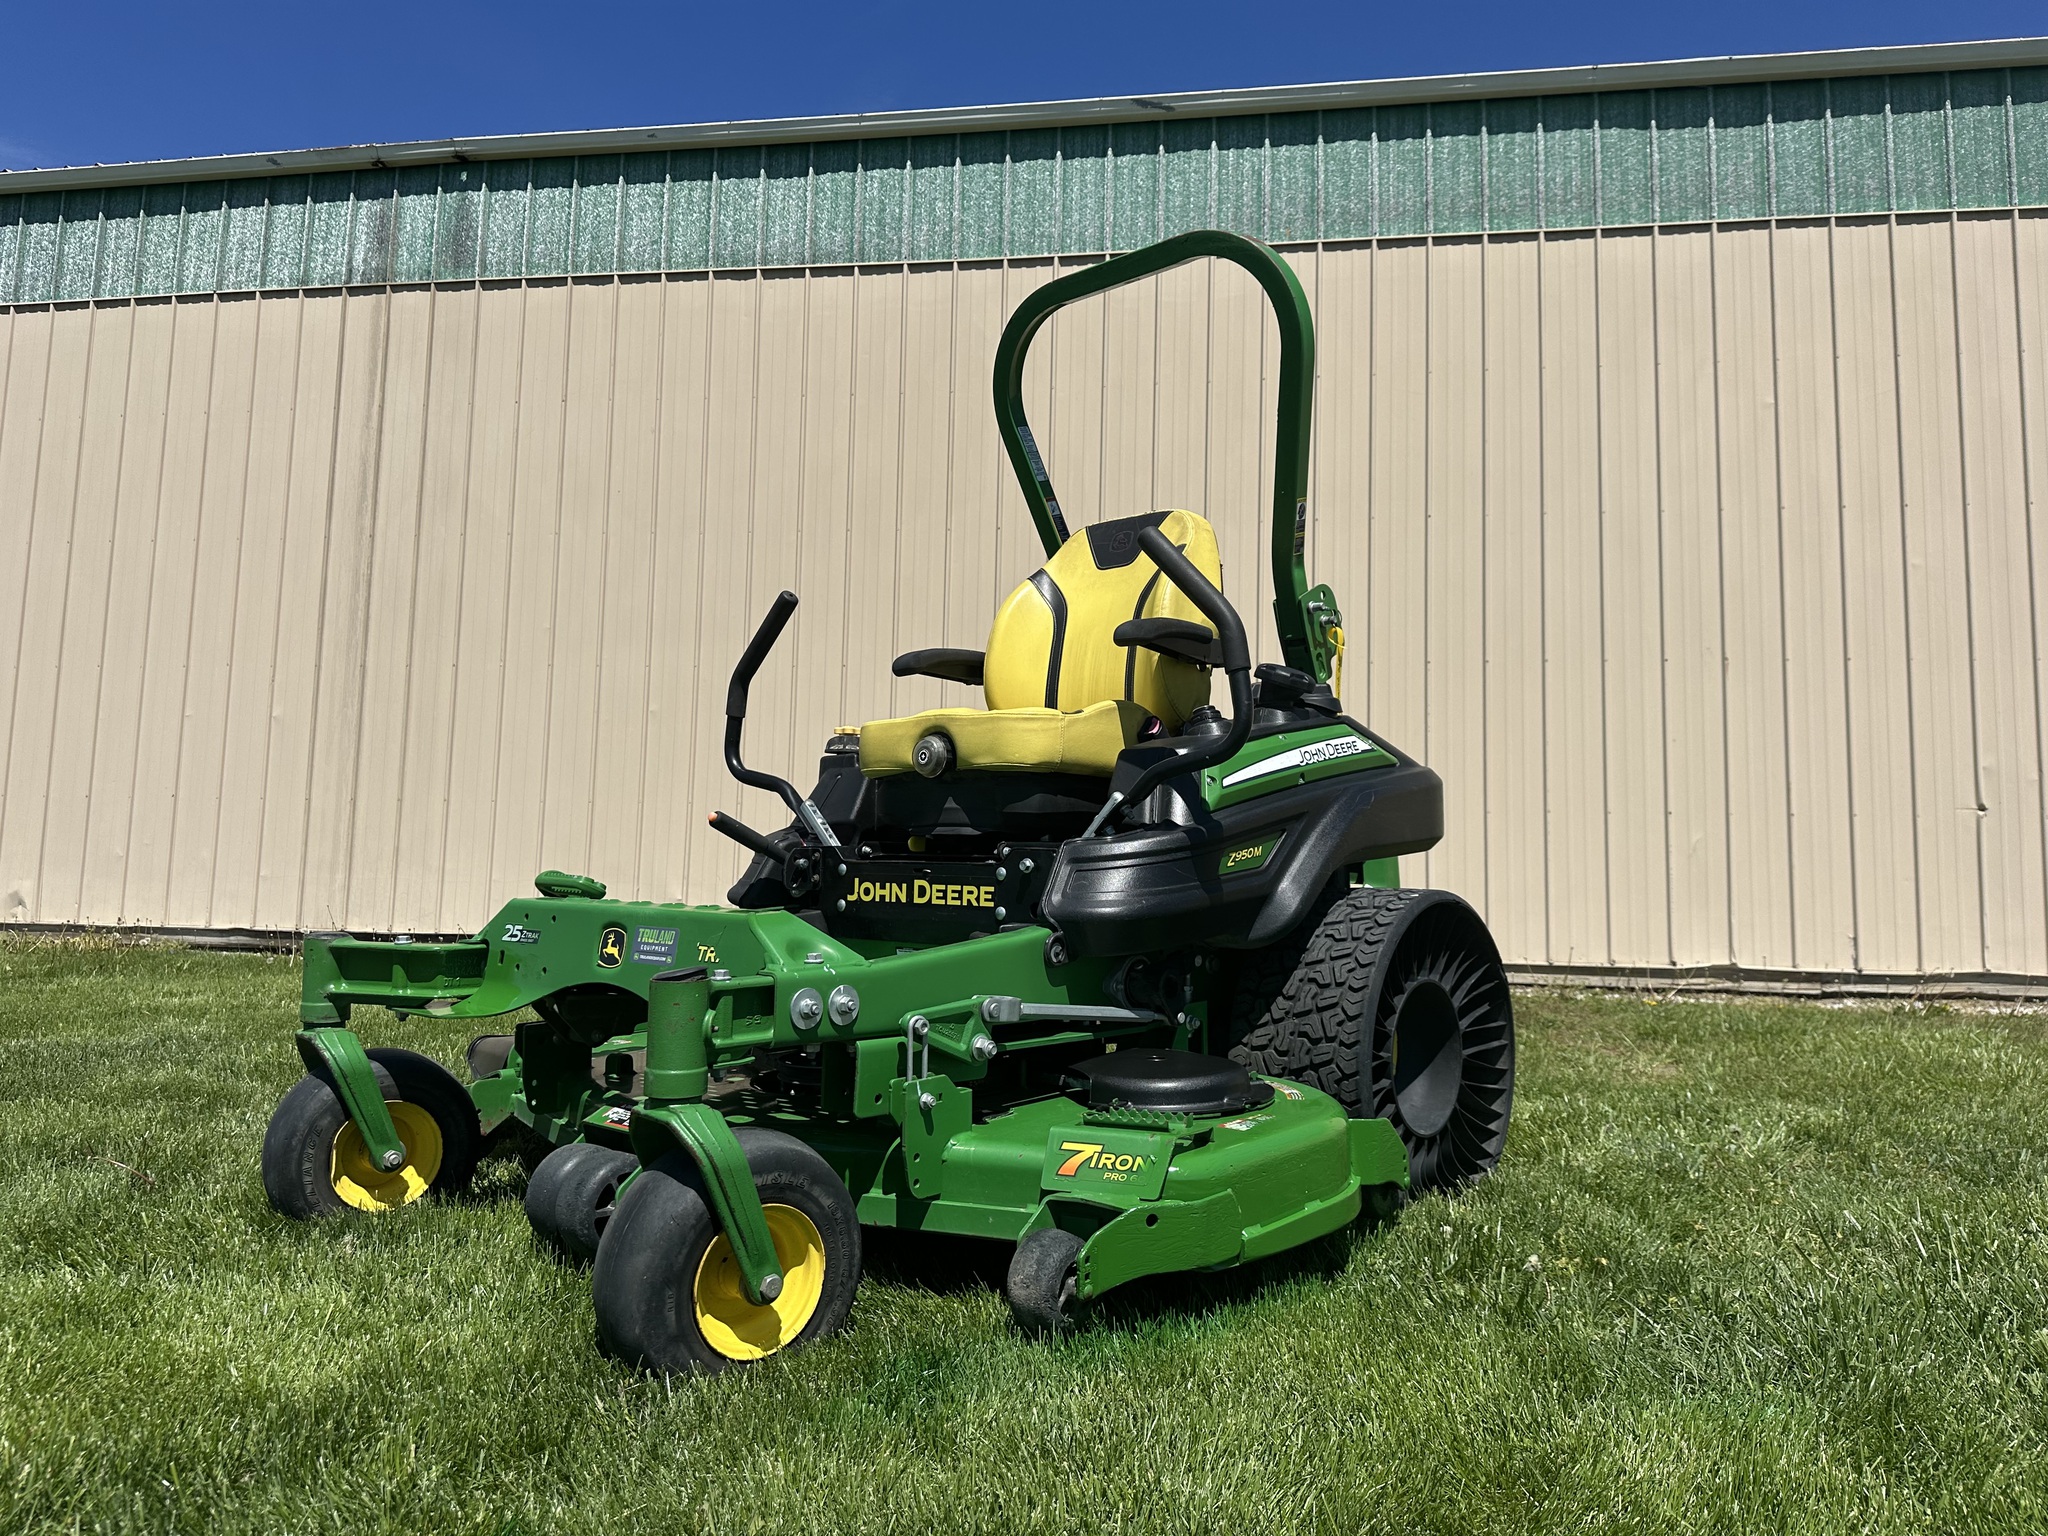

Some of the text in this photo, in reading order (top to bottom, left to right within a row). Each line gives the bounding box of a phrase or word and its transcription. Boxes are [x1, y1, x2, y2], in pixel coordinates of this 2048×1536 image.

[1299, 741, 1360, 764] JOHN DEERE
[1227, 846, 1263, 867] Z950M
[847, 877, 995, 907] JOHN DEERE
[501, 924, 523, 942] 25
[637, 928, 676, 945] TRULAND
[640, 944, 669, 952] EQUIPMENT
[1103, 1172, 1128, 1182] PRO
